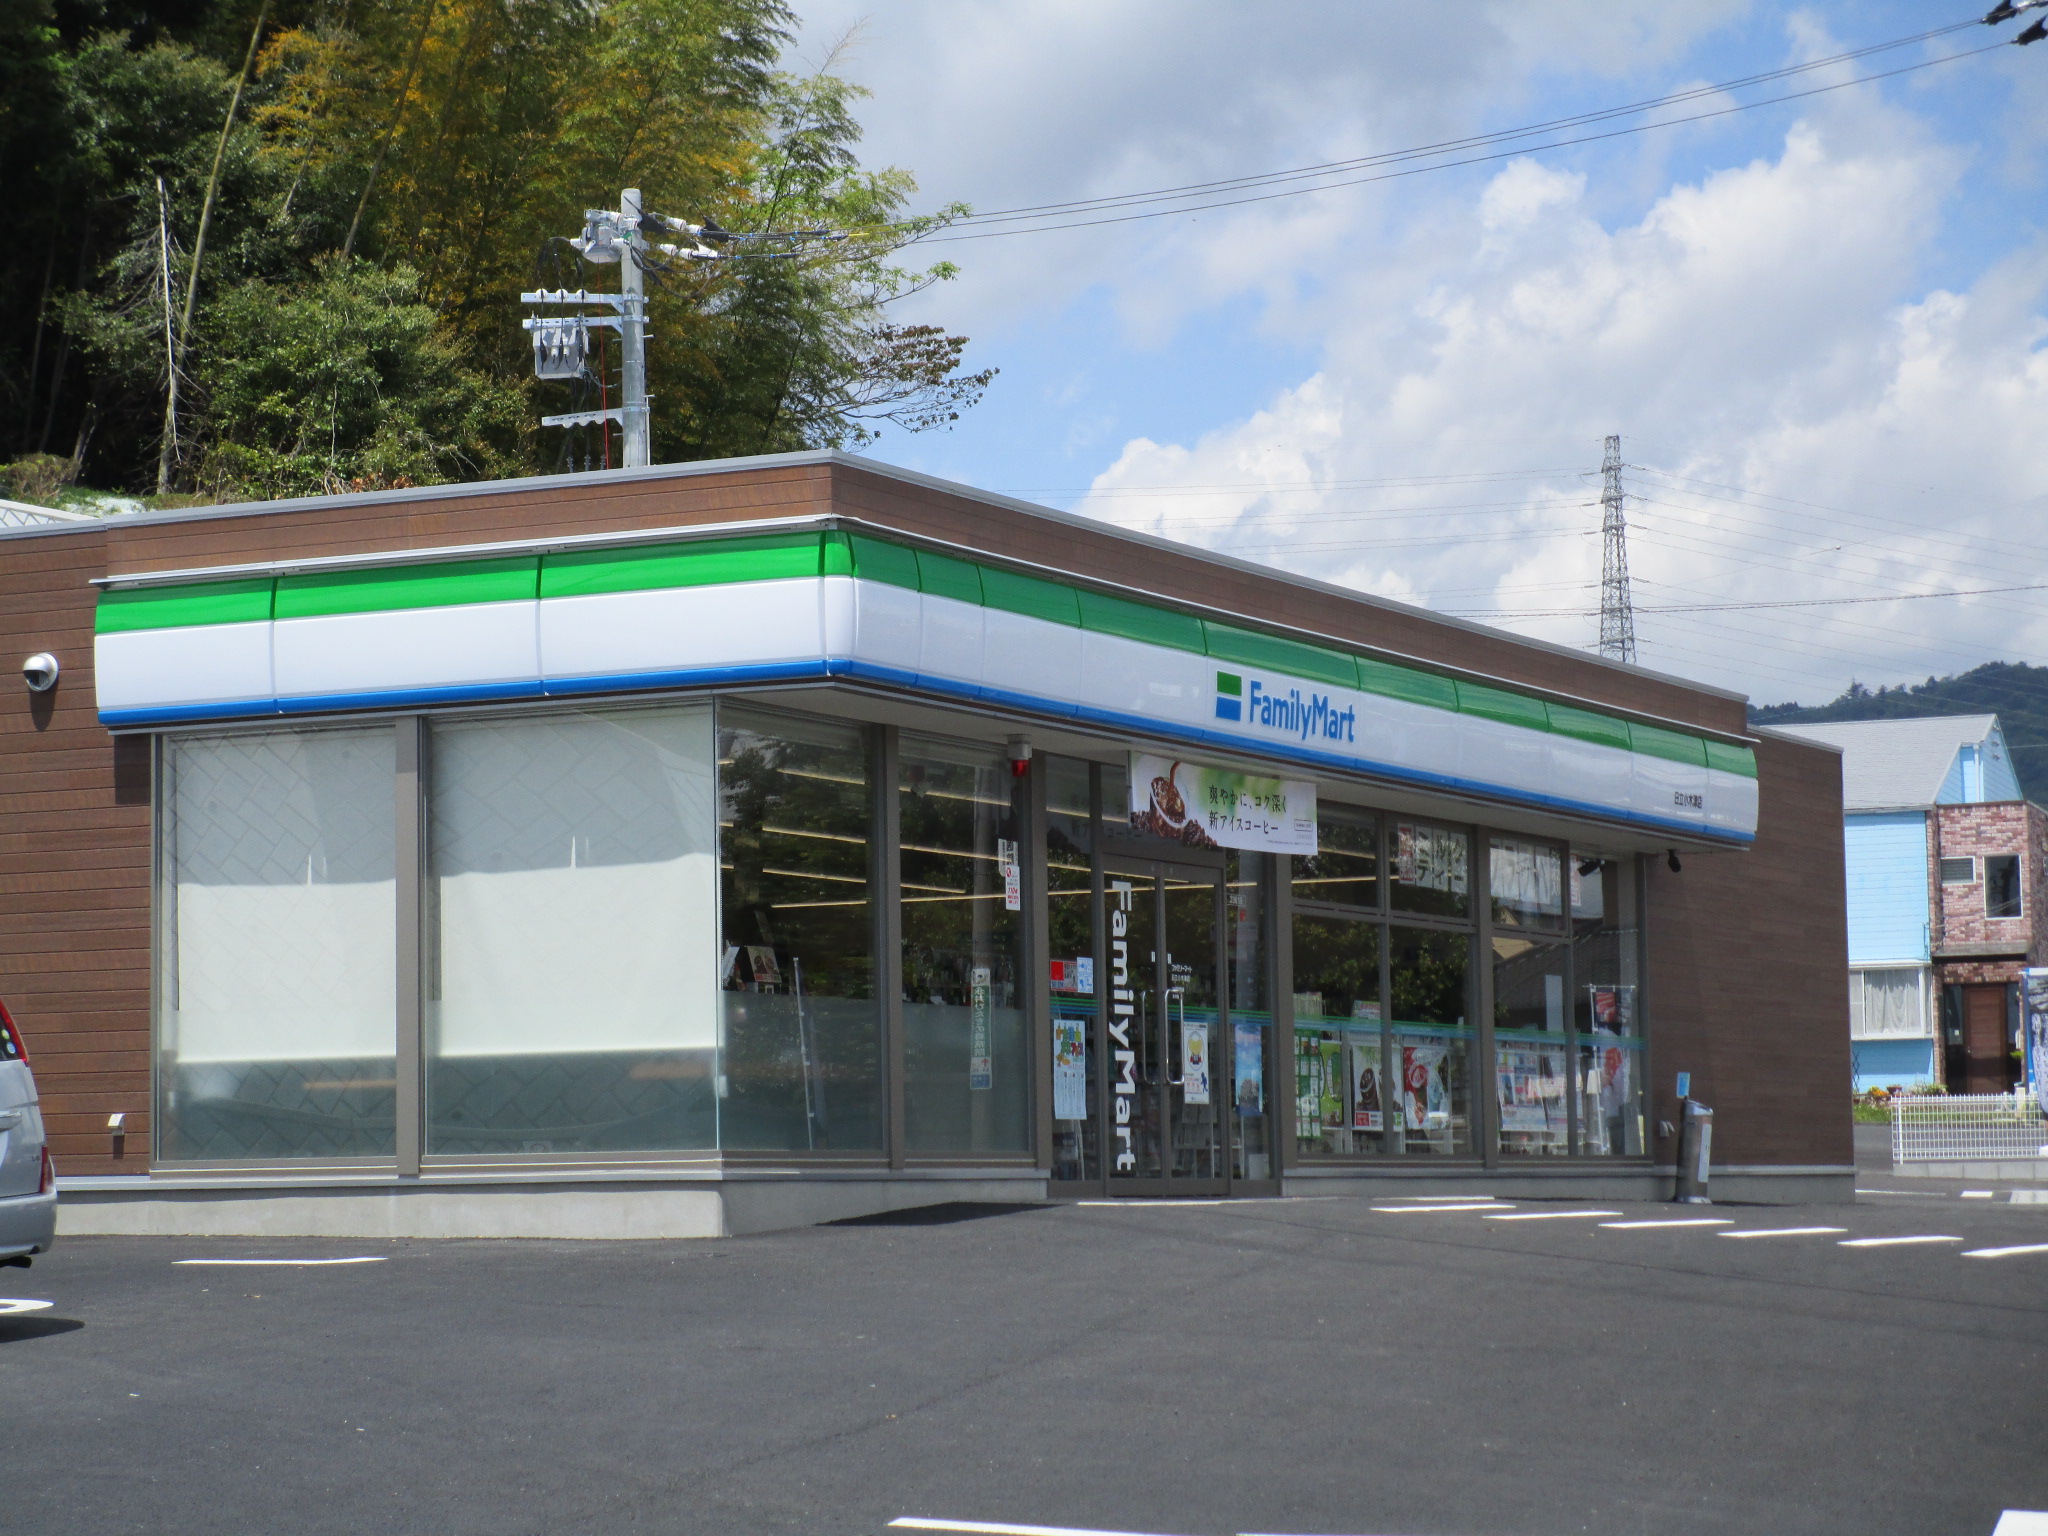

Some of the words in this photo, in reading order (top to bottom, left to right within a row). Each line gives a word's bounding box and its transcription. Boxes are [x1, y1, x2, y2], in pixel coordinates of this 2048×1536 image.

[1250, 680, 1355, 742] FamilyMart
[1209, 784, 1287, 813] 爽やかに、コク深く
[1209, 809, 1279, 834] 新アイスコーヒー
[1109, 881, 1136, 1171] FamilyMart
